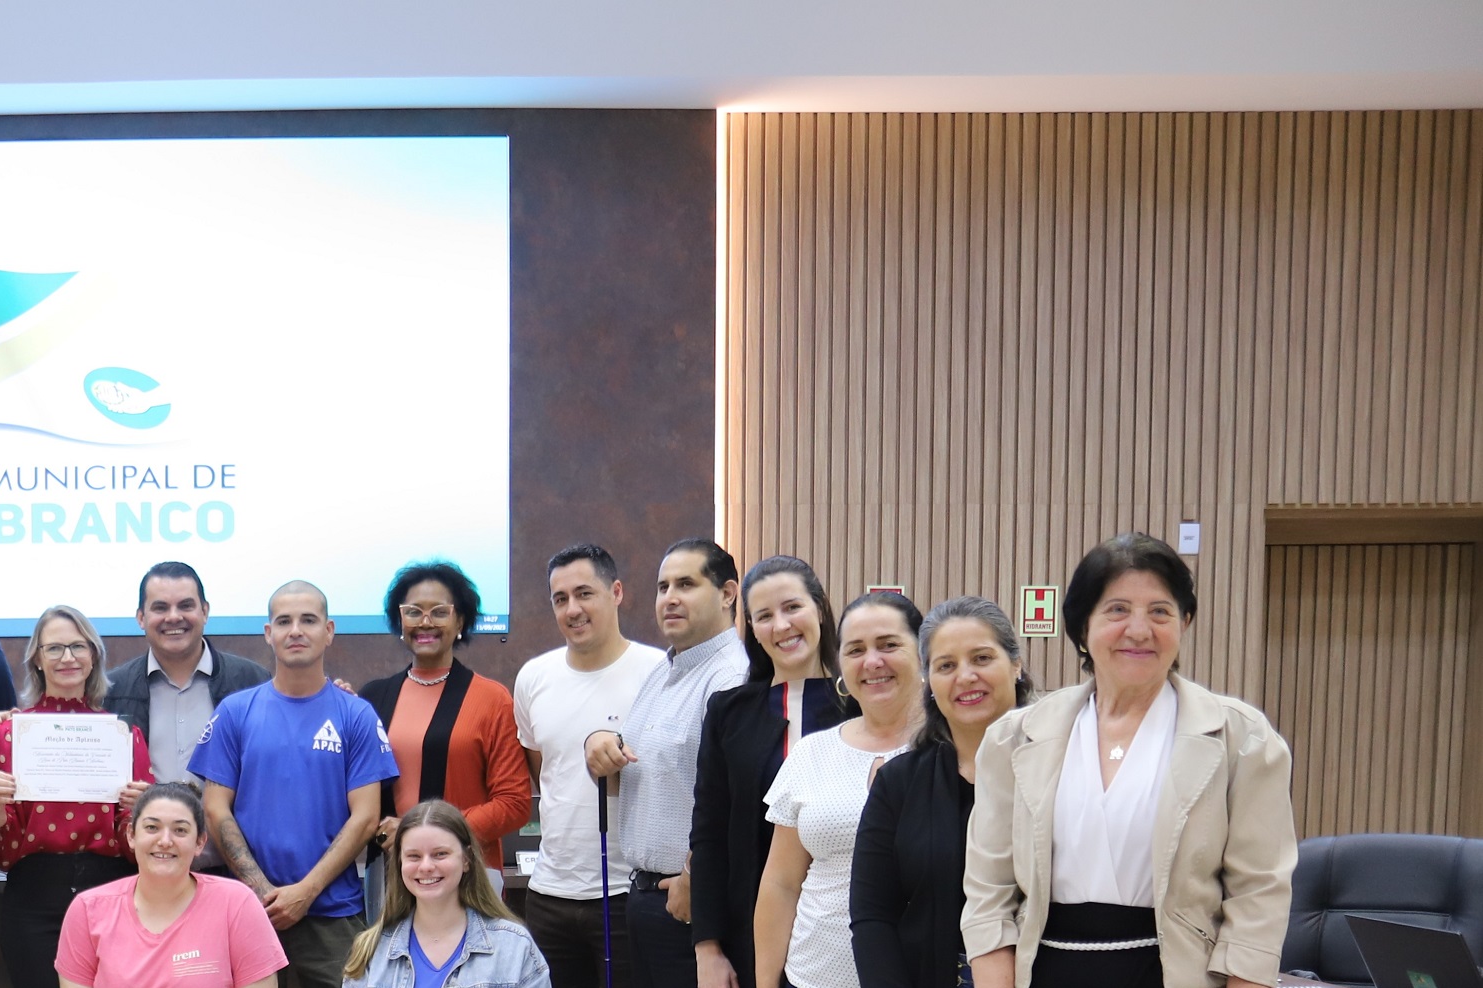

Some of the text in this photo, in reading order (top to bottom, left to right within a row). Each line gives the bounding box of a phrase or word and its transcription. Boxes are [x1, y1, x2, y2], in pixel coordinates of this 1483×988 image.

[193, 464, 237, 489] DE
[1026, 590, 1054, 619] H
[312, 740, 342, 753] APAC
[172, 949, 200, 961] trem
